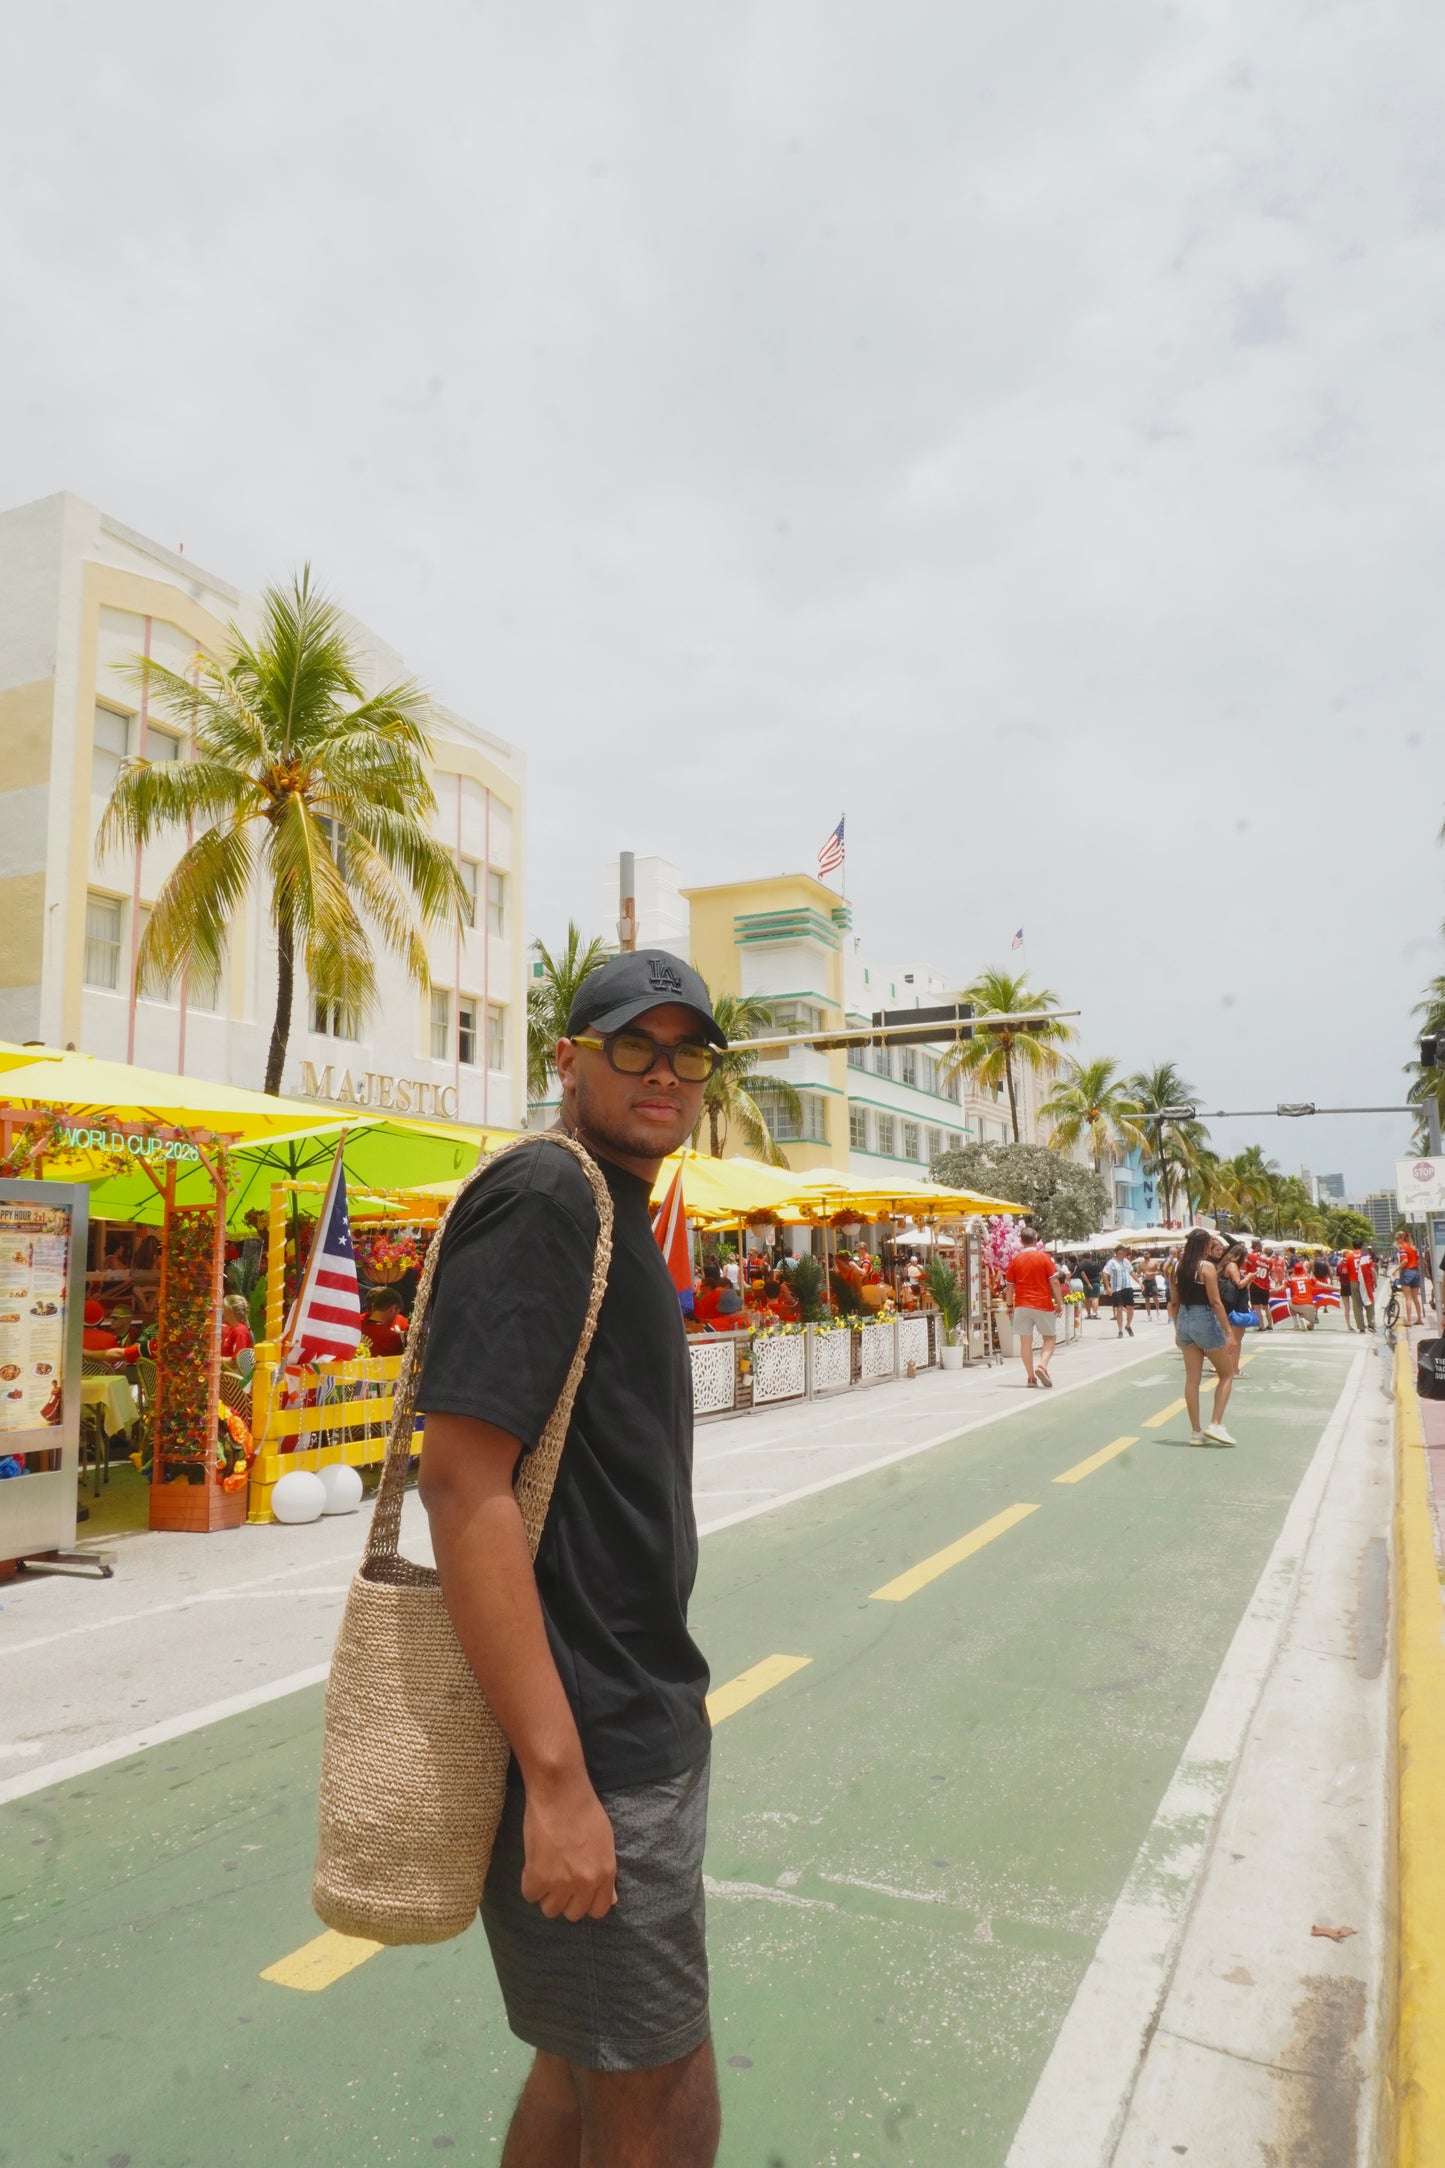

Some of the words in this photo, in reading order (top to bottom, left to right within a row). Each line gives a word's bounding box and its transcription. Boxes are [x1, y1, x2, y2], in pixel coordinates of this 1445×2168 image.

[648, 959, 682, 996] LA
[301, 1061, 457, 1118] MAJESTIC
[59, 1127, 124, 1152] WORLD
[127, 1135, 162, 1155] CUP
[165, 1142, 199, 1161] 2026
[1414, 1168, 1434, 1176] STOP
[15, 1210, 31, 1221] HOUR
[1297, 1281, 1306, 1294] 5
